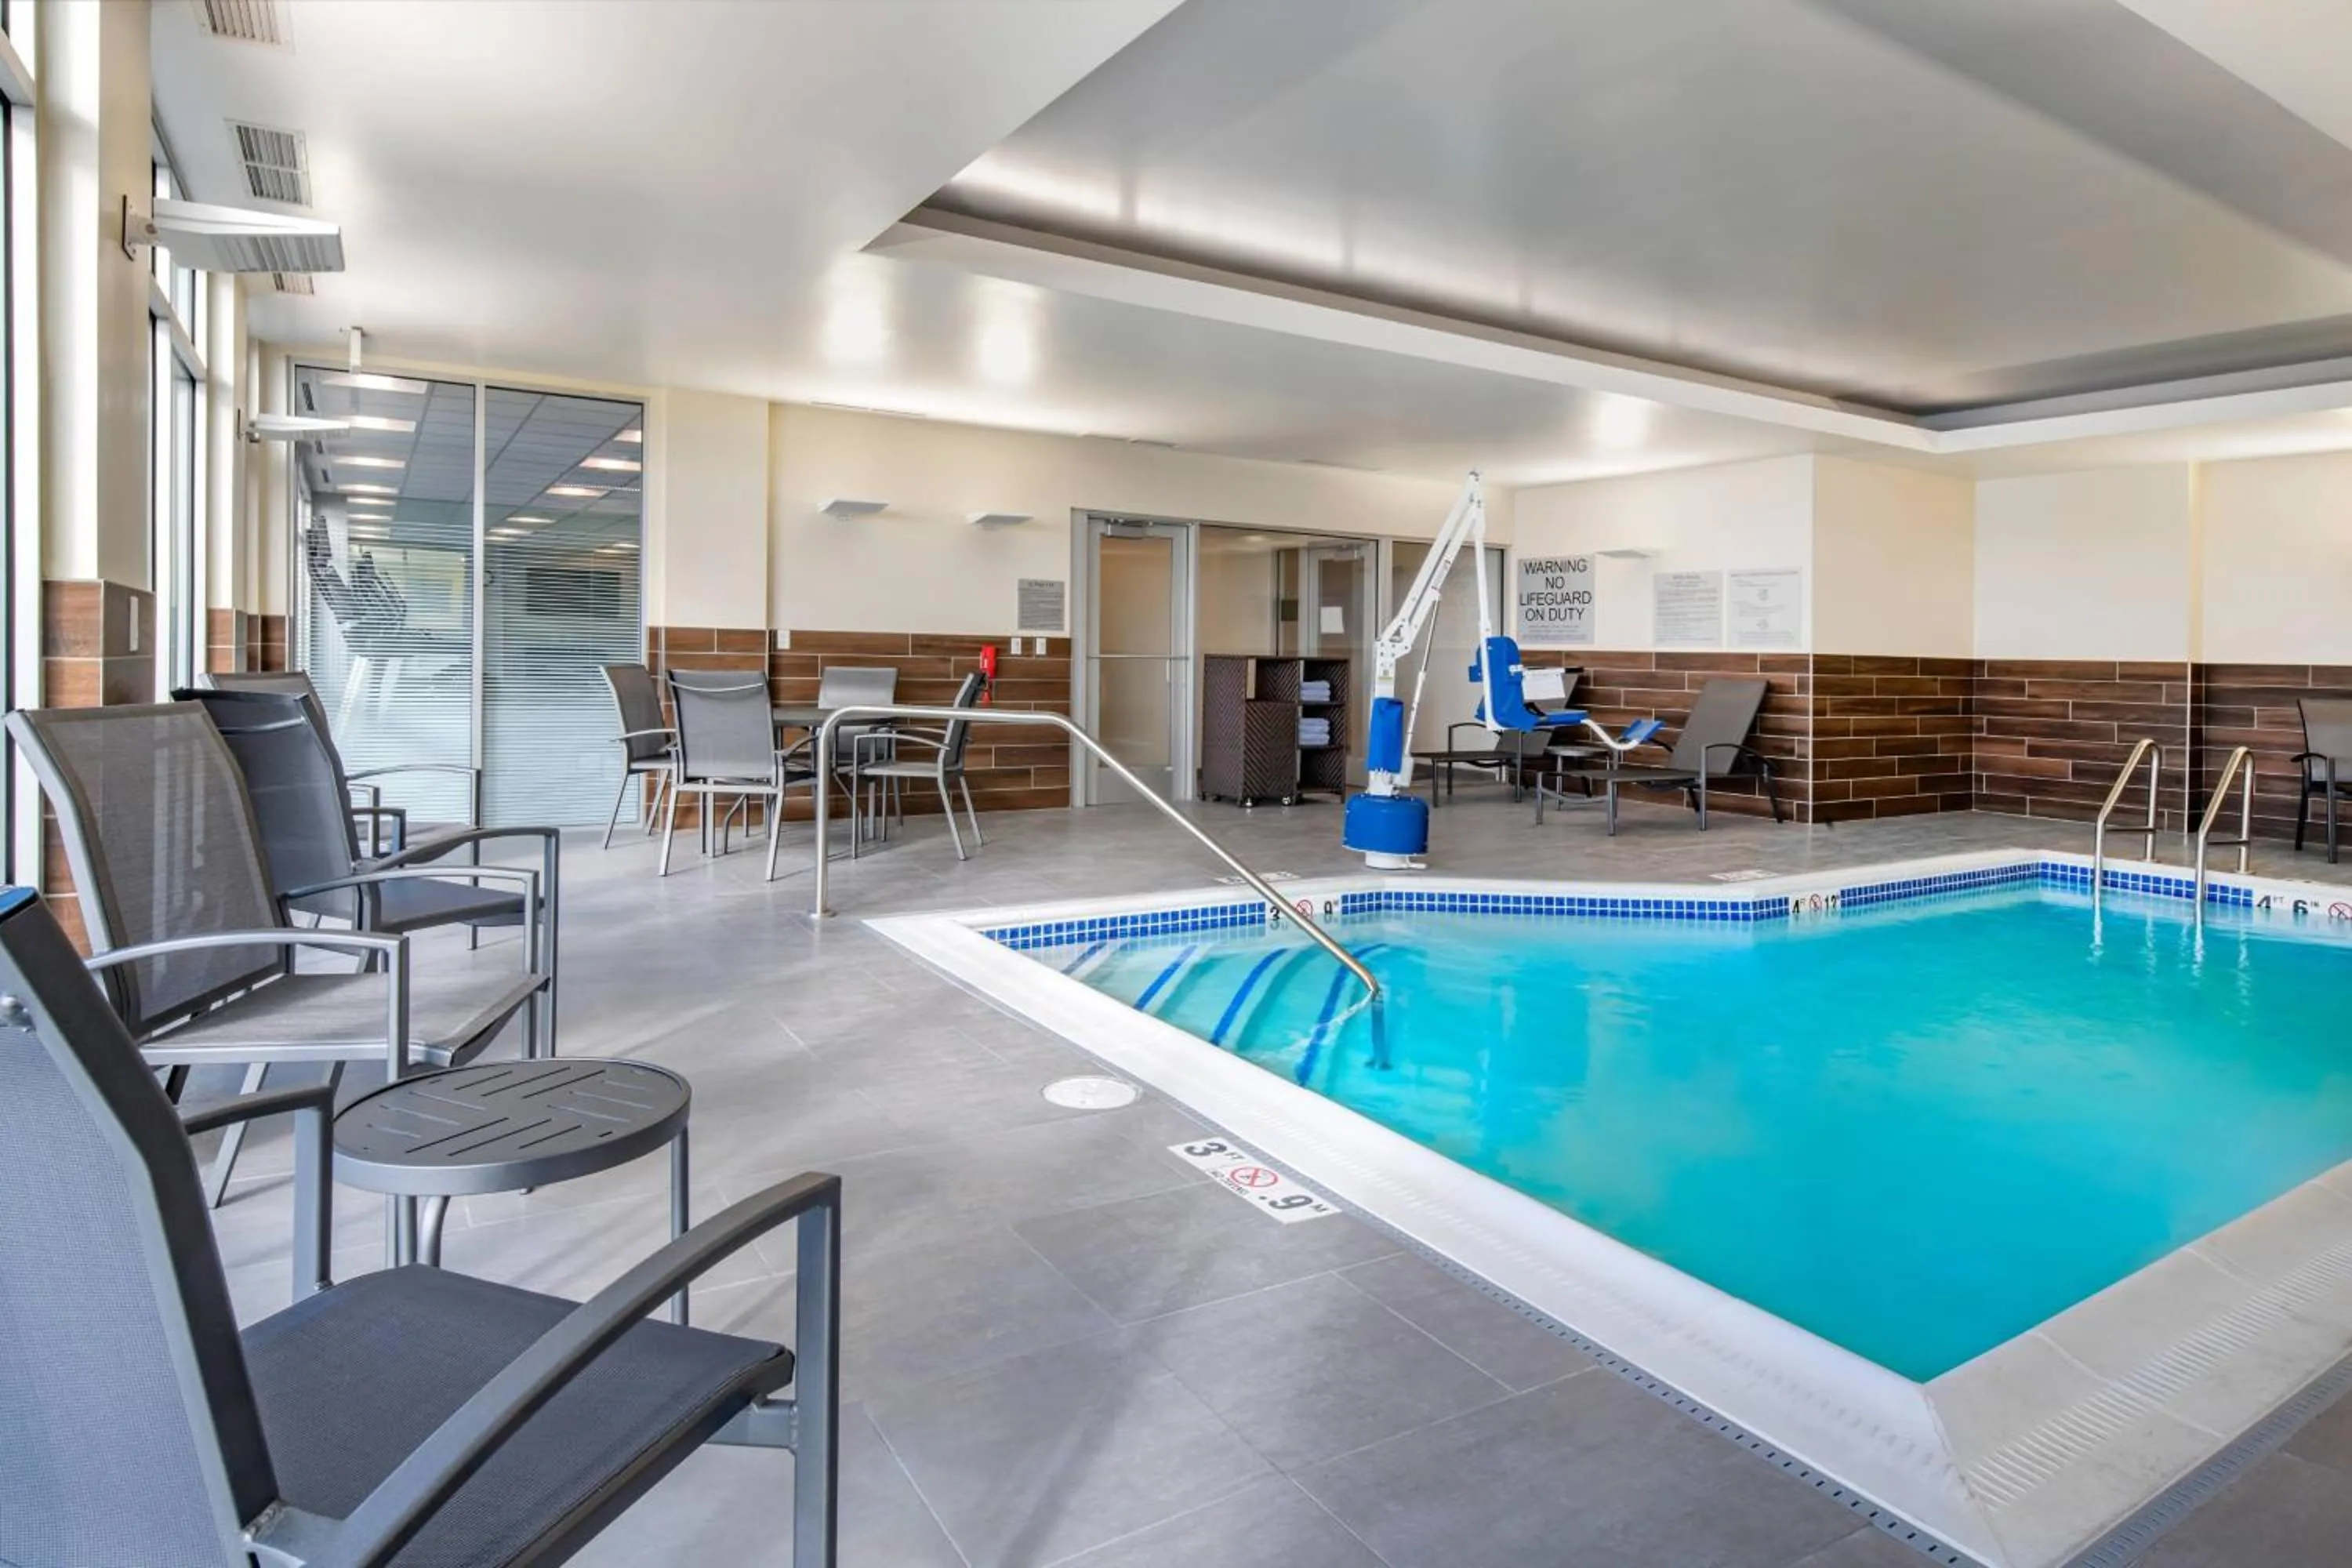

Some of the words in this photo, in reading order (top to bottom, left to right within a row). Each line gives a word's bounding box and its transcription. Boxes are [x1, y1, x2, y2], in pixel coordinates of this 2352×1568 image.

[1524, 559, 1588, 574] WARNING
[1545, 576, 1566, 590] NO
[1519, 590, 1592, 606] LIFEGUARD
[1525, 608, 1544, 622] ON
[1548, 608, 1584, 622] DUTY
[1792, 898, 1801, 913] 4
[2256, 895, 2271, 909] 4
[2293, 899, 2309, 913] 6
[1269, 906, 1280, 921] 3
[1185, 1142, 1228, 1157] 3
